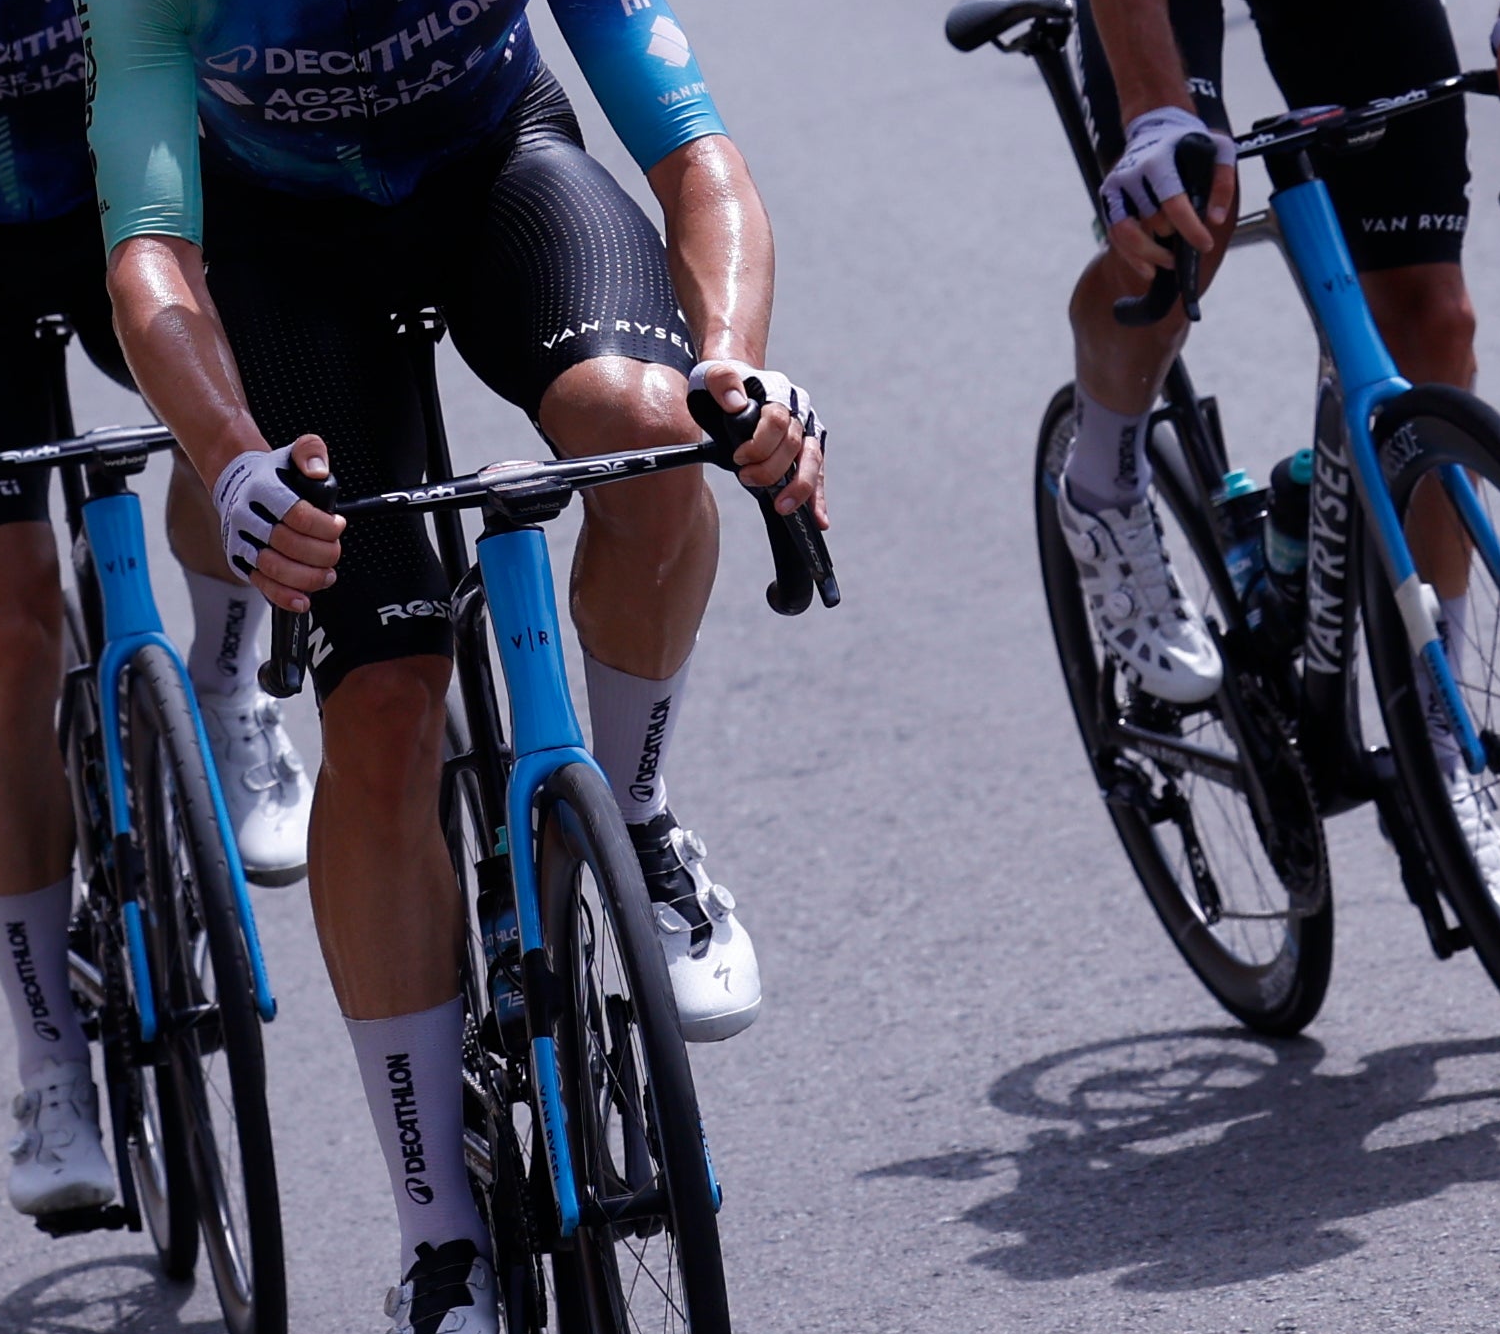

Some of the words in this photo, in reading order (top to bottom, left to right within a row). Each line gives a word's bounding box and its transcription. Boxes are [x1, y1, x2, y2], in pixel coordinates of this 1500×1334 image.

[264, 44, 486, 123] MONDIALE
[397, 59, 455, 91] LA
[657, 85, 693, 107] VAN
[1362, 216, 1408, 232] VAN
[543, 320, 600, 350] VAN
[615, 320, 694, 359] RYSEL
[1307, 439, 1351, 580] RYSEL
[635, 694, 672, 783] DECATHLON
[5, 921, 51, 1019] DECATHLON
[386, 1053, 426, 1175] DECATHLON
